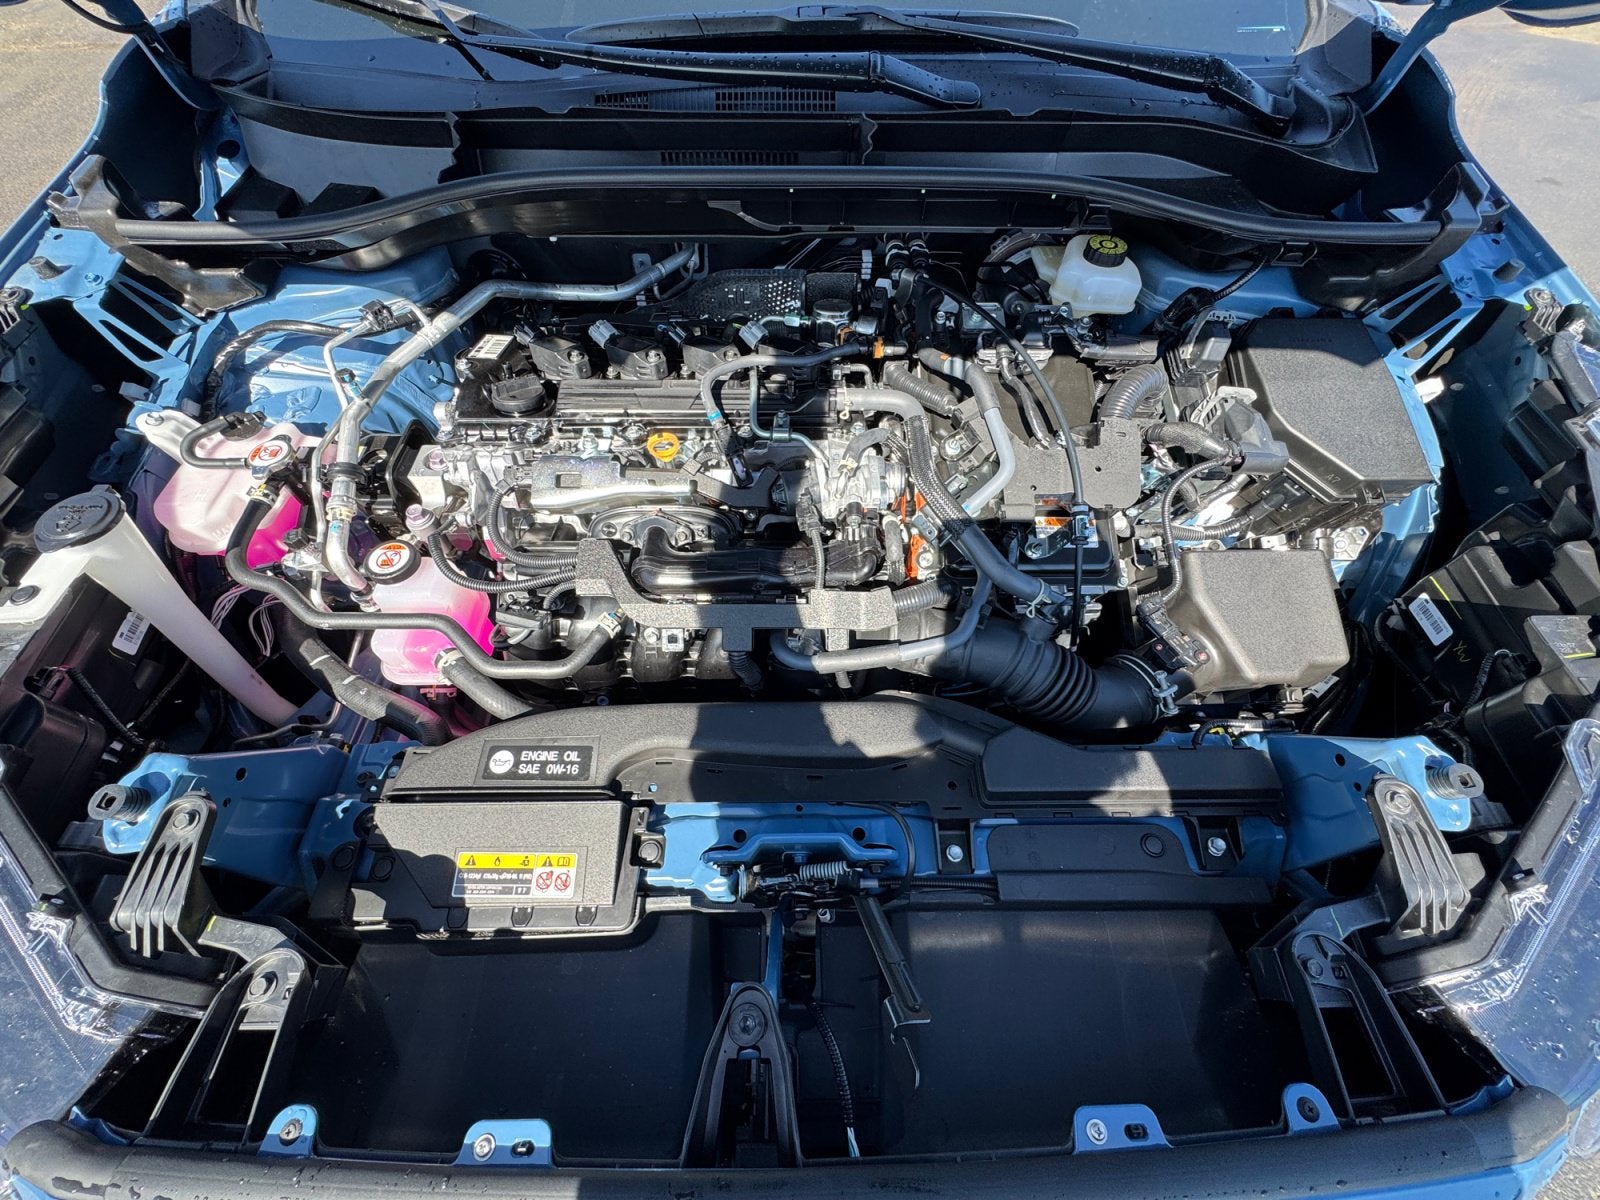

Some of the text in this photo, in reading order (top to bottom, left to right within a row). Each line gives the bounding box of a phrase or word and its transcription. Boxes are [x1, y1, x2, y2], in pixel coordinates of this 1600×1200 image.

[520, 750, 581, 762] ENGINE OIL
[518, 763, 579, 775] SAE 0W-16
